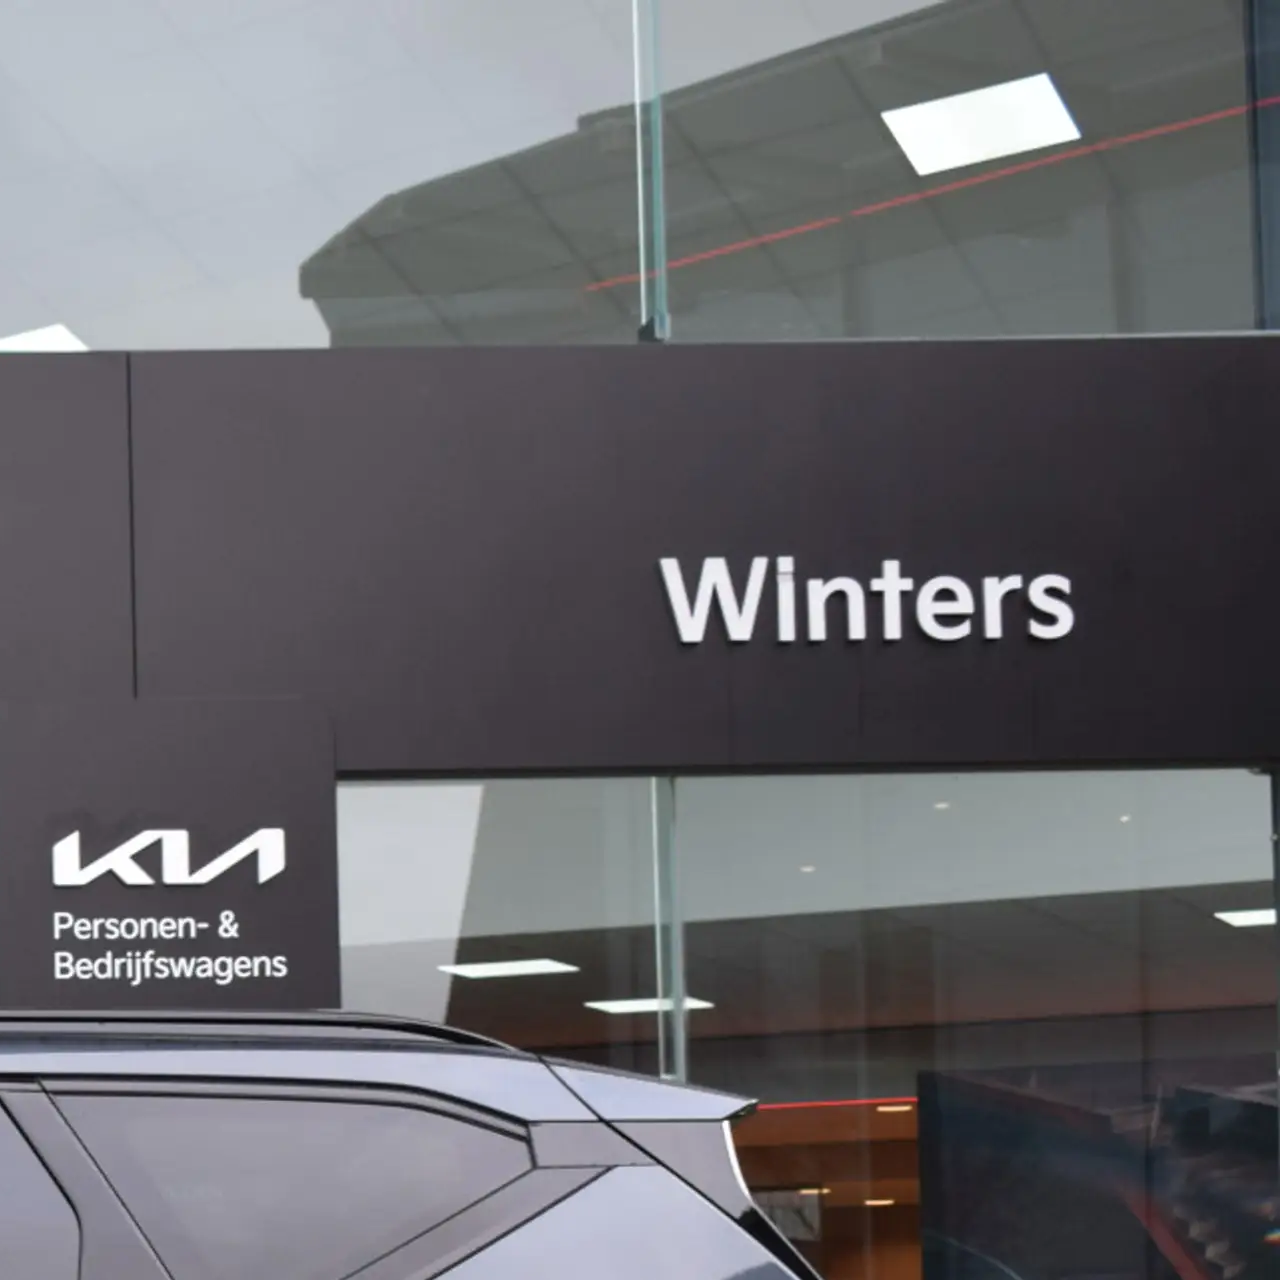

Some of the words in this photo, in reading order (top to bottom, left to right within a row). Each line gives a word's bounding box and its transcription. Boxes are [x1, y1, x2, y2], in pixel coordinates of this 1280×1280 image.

[659, 555, 1075, 643] Winters
[52, 827, 286, 887] KIA
[53, 911, 209, 941] Personen-
[217, 909, 240, 939] &
[53, 949, 288, 987] Bedrijfswagens
